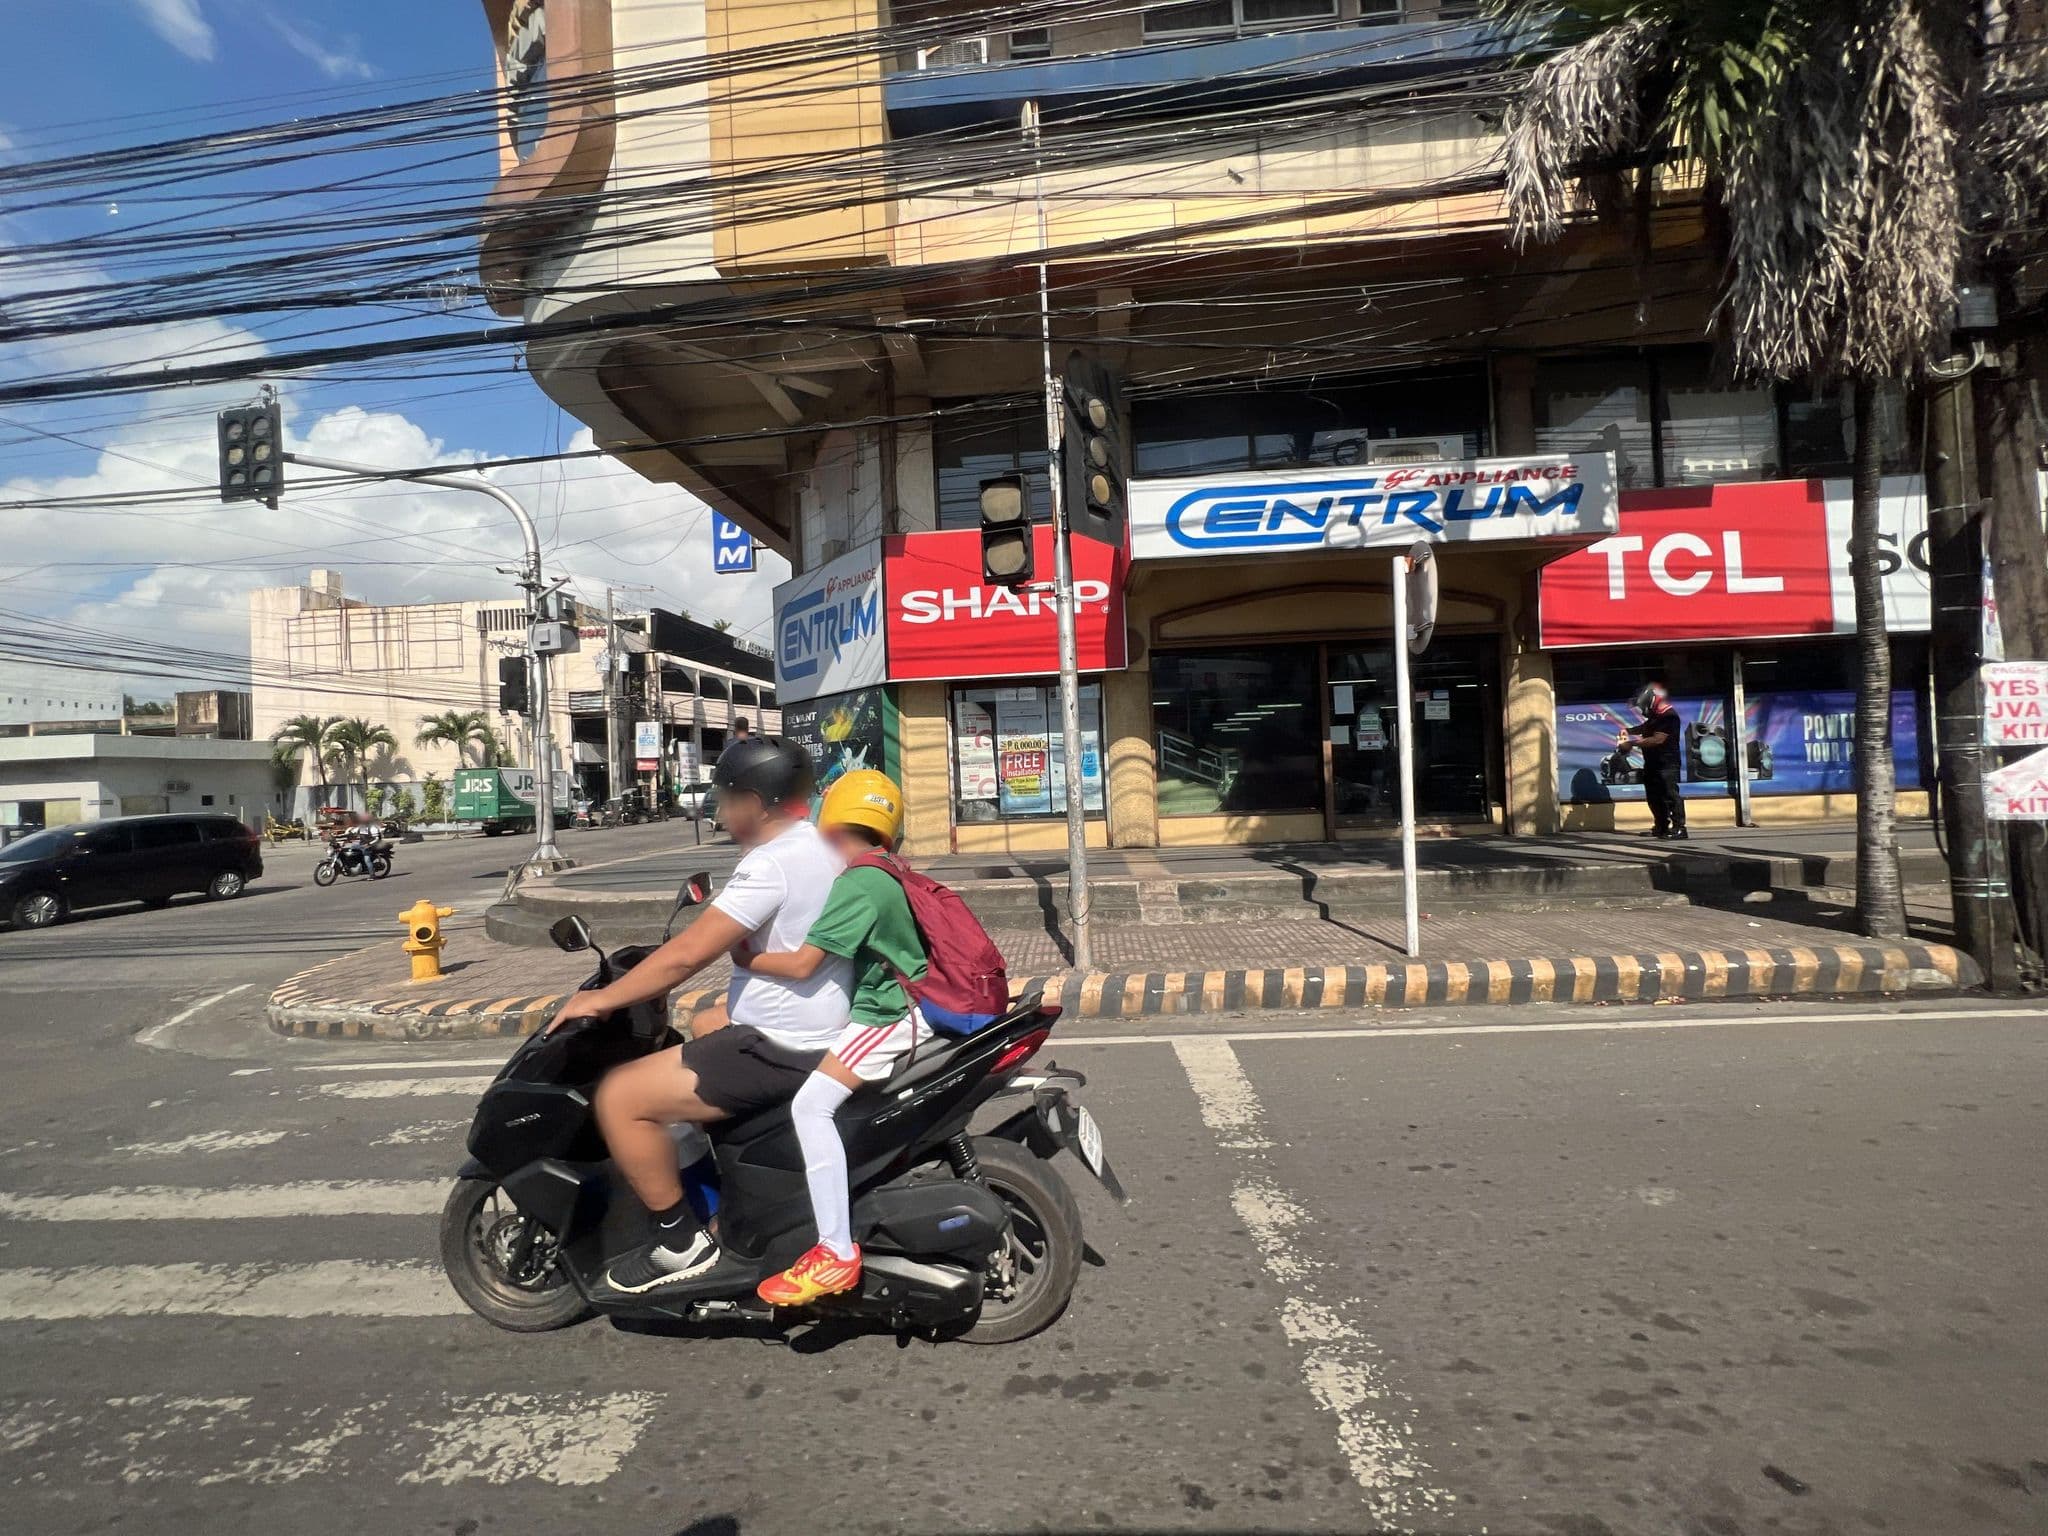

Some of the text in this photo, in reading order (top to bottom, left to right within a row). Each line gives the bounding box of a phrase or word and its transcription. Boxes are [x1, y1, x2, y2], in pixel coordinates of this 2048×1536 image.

[1423, 465, 1580, 488] APPLIANCE
[1165, 477, 1584, 549] CENTRUM
[1587, 530, 1784, 600] TCL
[836, 567, 877, 593] APPLIANCE
[778, 587, 878, 681] CENTRUM
[1989, 679, 2039, 697] YES
[1565, 712, 1608, 722] SONY
[1990, 701, 2041, 718] JVA
[1006, 752, 1041, 769] FREE
[1804, 742, 1840, 762] YOUR
[1006, 768, 1041, 777] Installation
[460, 778, 493, 792] JRS
[514, 775, 534, 790] JR
